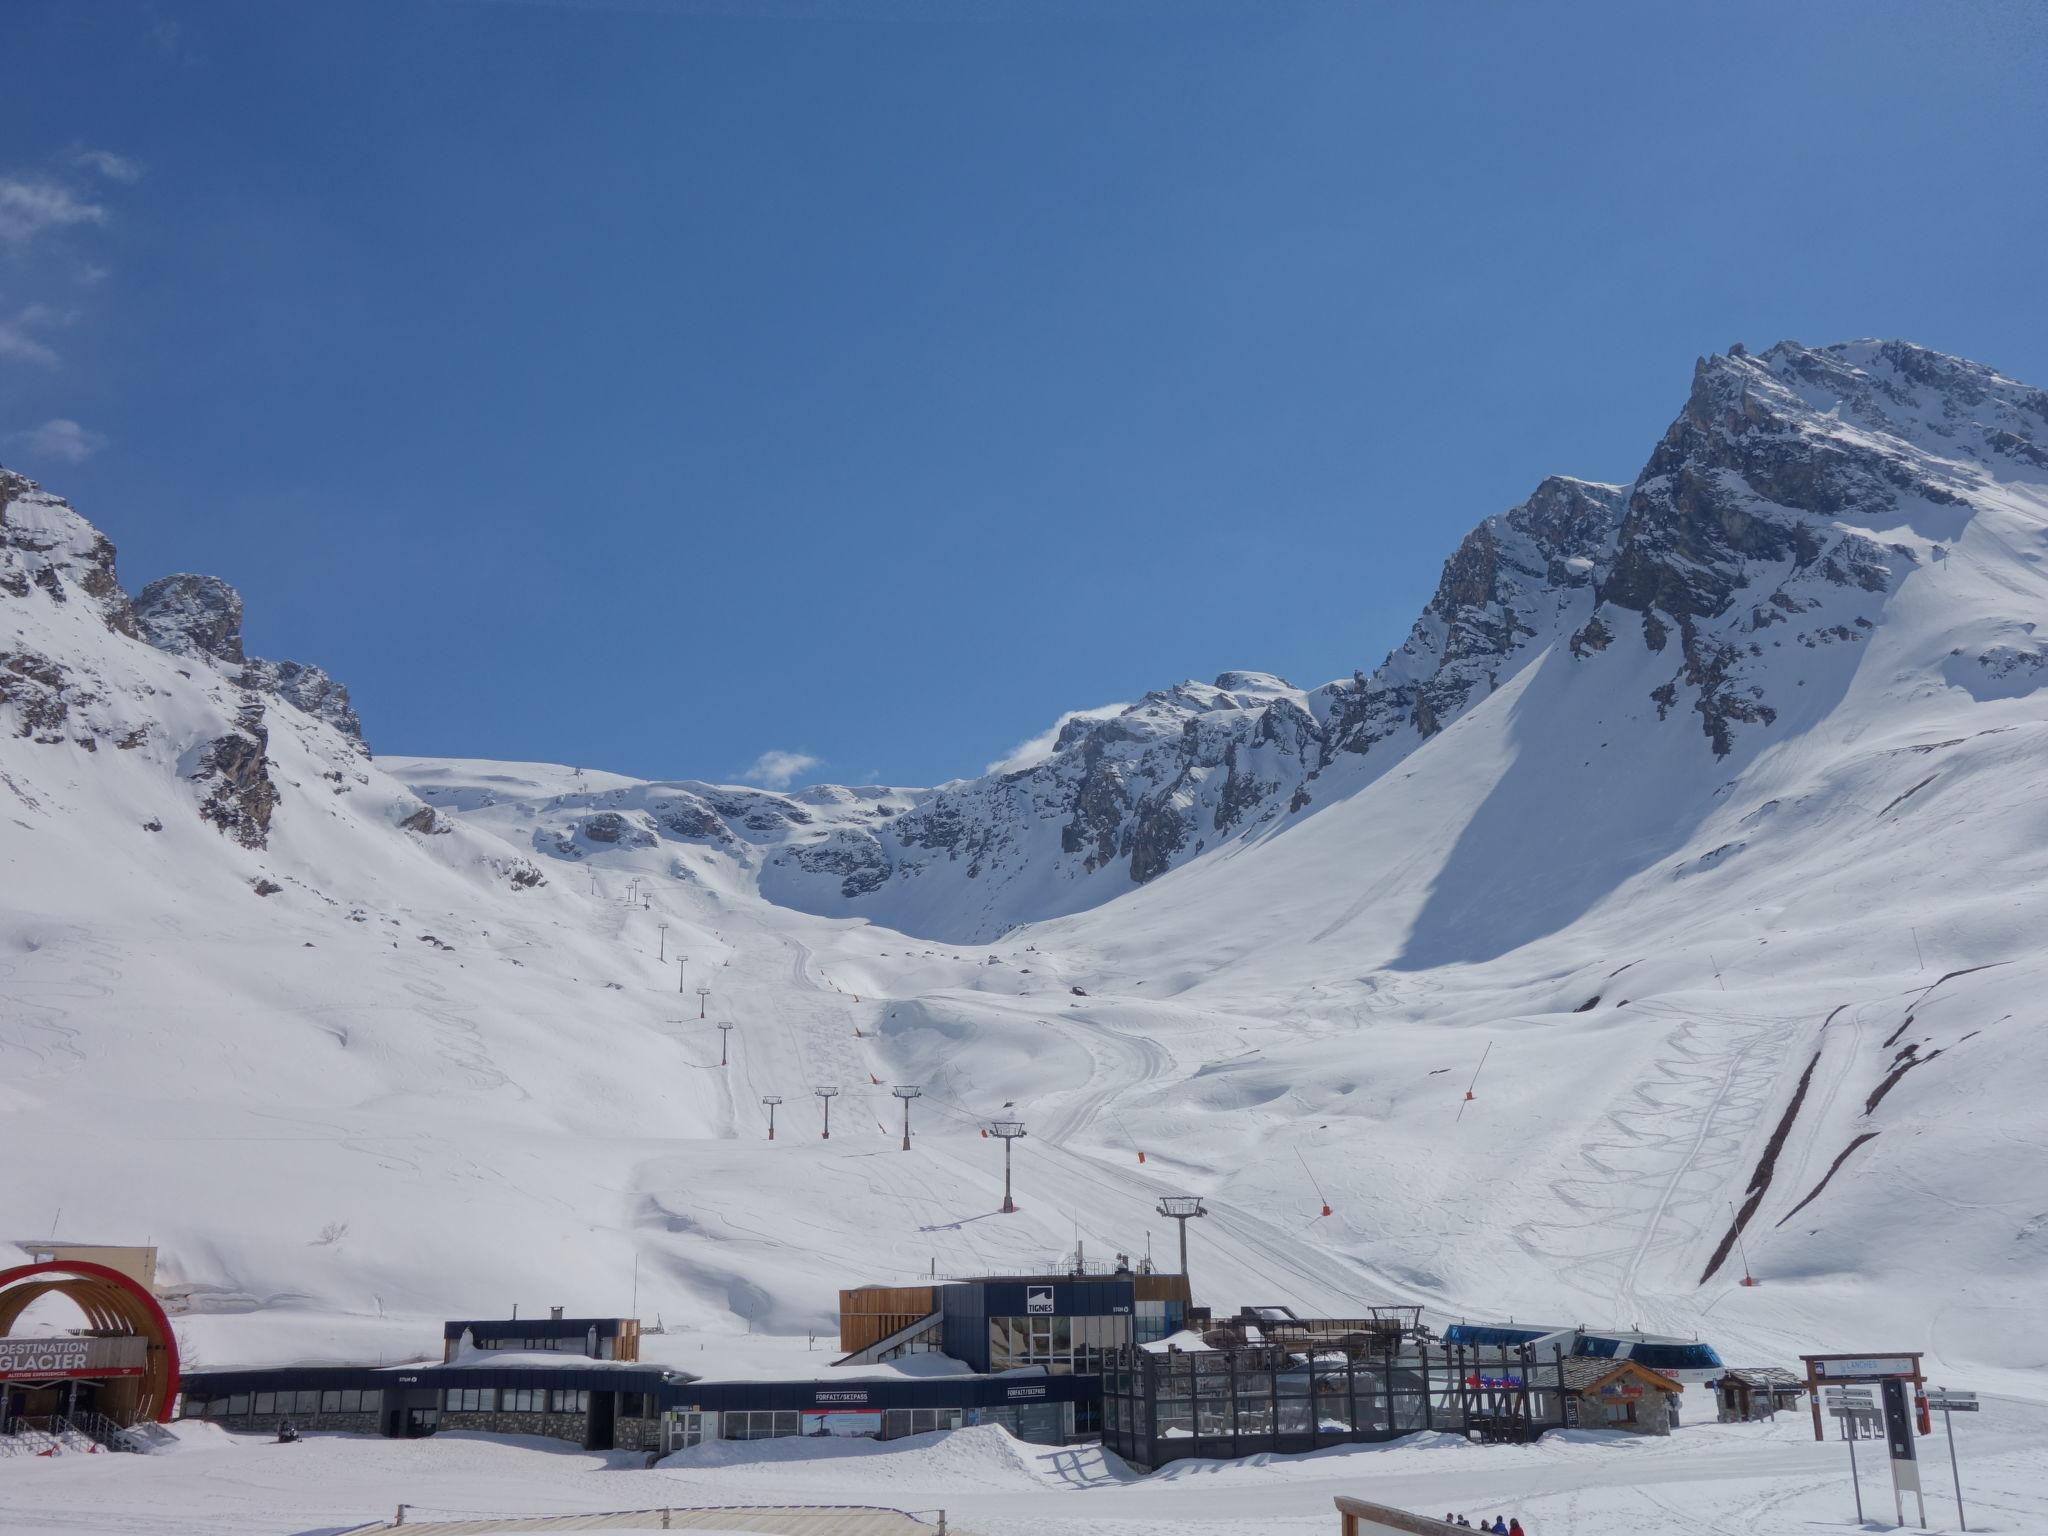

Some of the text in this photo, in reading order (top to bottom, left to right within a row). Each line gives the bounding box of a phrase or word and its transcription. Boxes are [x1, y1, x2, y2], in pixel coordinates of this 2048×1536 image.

[1029, 1304, 1053, 1313] TIGNES
[0, 1342, 89, 1355] DESTINATION
[0, 1354, 87, 1371] GLACIER
[815, 1393, 868, 1401] FORFAIT/SKIPASS
